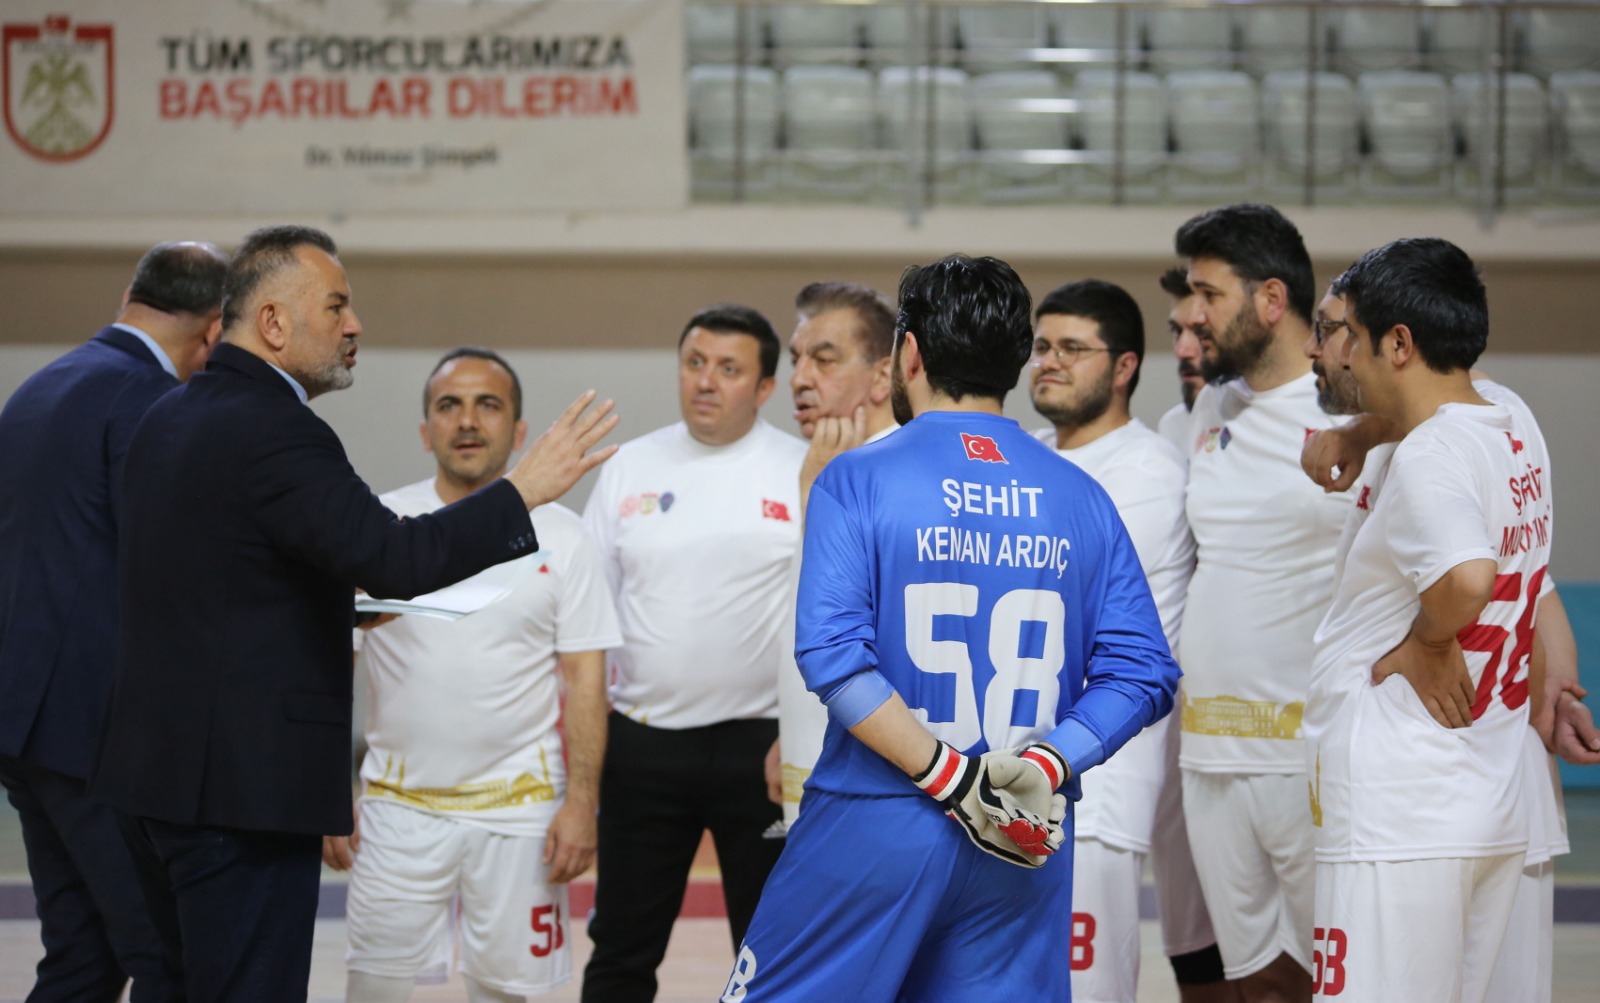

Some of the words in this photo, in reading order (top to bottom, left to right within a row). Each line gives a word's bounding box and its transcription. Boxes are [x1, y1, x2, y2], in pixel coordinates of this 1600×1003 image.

[161, 35, 253, 73] TÜM
[265, 37, 632, 72] SPORCULARIMIZA
[158, 77, 431, 128] BAŞARILAR
[941, 478, 1043, 517] ŞEHİT
[916, 525, 990, 566] KENAN
[996, 533, 1070, 579] ARDIÇ
[904, 582, 1065, 753] 58
